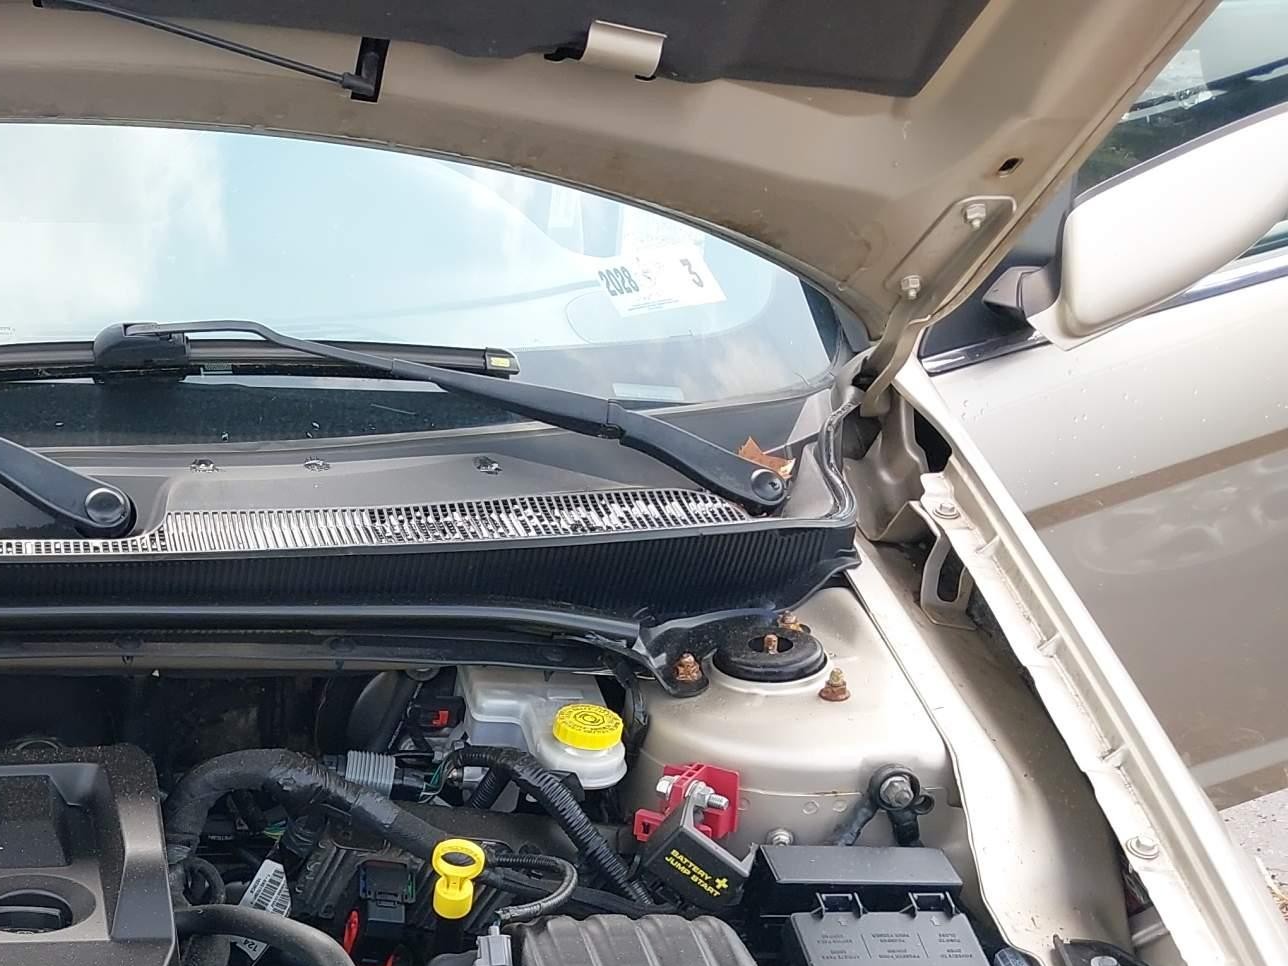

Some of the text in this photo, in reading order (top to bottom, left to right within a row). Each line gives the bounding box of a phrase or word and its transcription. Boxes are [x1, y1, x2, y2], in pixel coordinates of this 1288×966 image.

[597, 266, 640, 296] 2028
[665, 856, 721, 897] JUMP START
[670, 849, 712, 882] BATTERY
